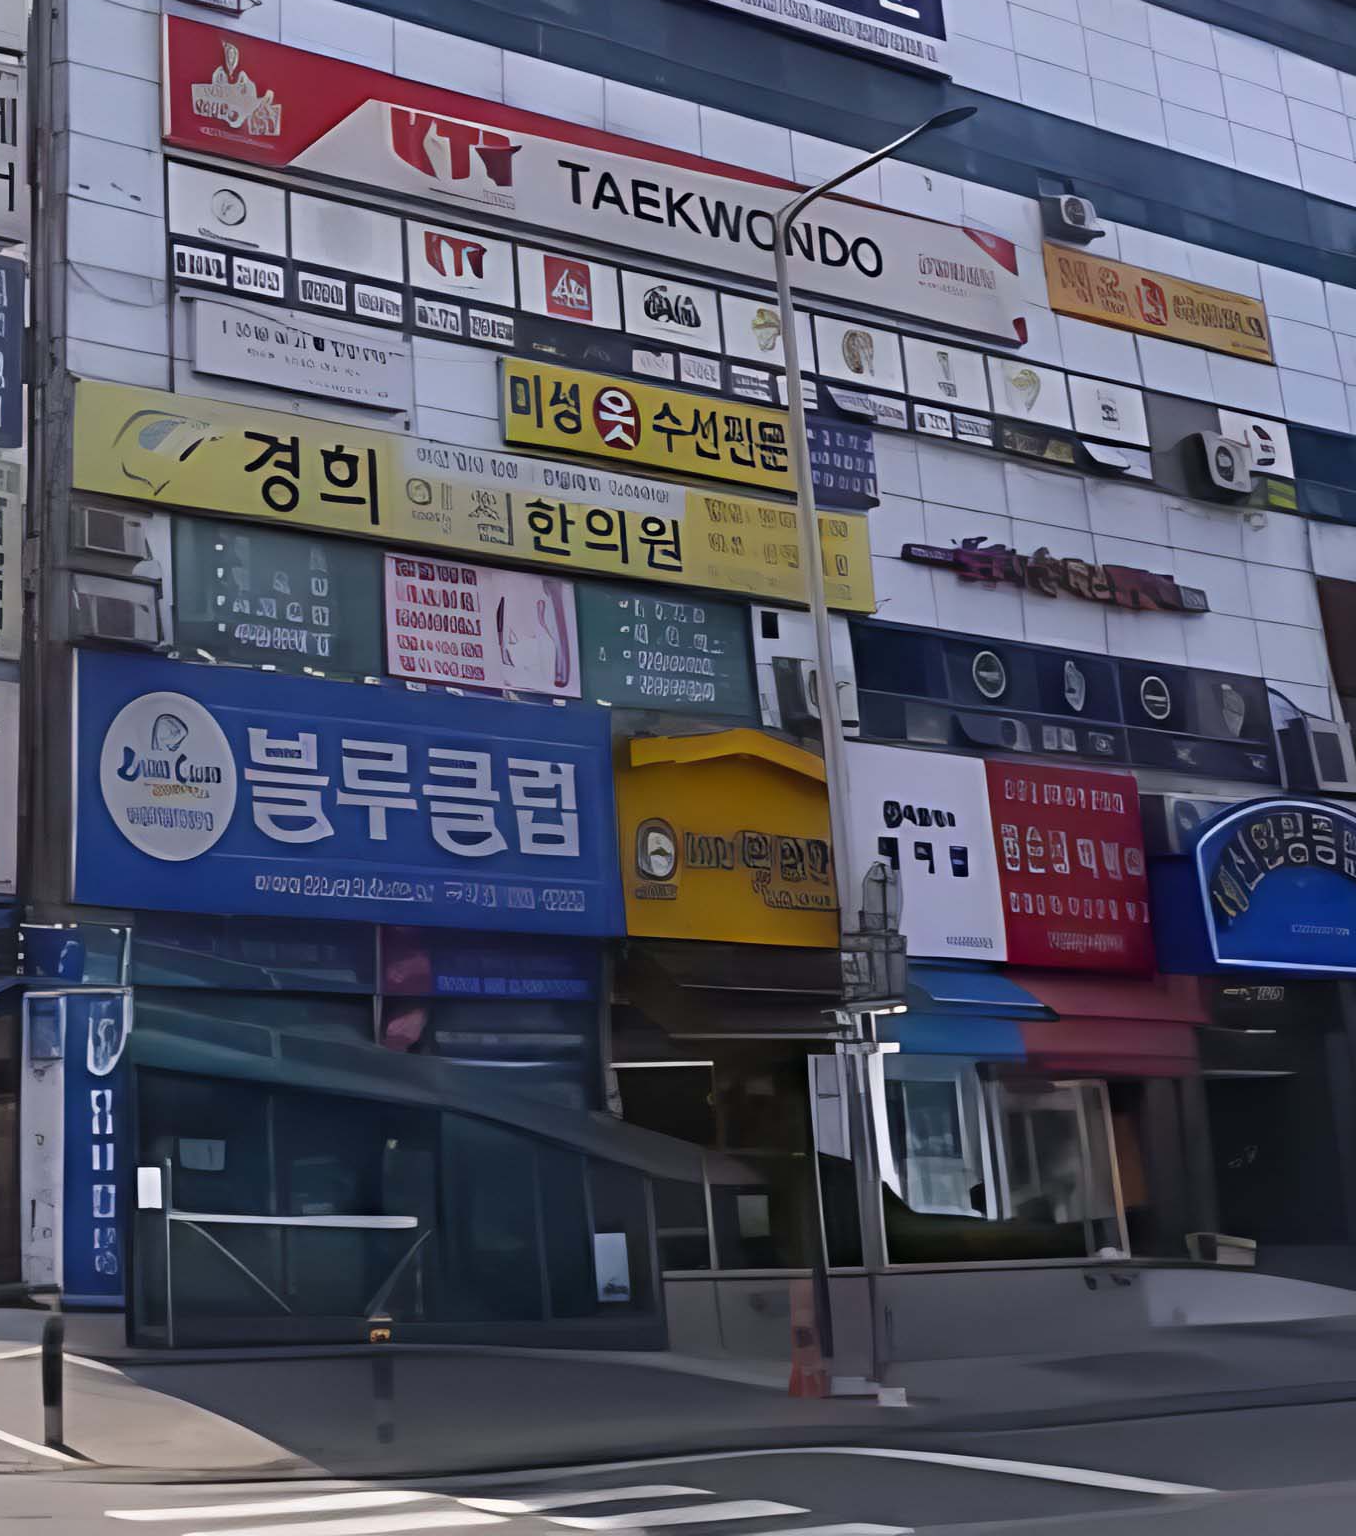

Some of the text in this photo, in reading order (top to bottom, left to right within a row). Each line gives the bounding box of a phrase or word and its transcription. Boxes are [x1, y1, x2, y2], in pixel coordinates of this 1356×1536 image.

[558, 160, 883, 278] TAEKWONDO
[510, 375, 582, 434] 미성
[243, 431, 381, 526] 경희
[525, 498, 684, 572] 한의원
[245, 727, 581, 857] 블루클럽
